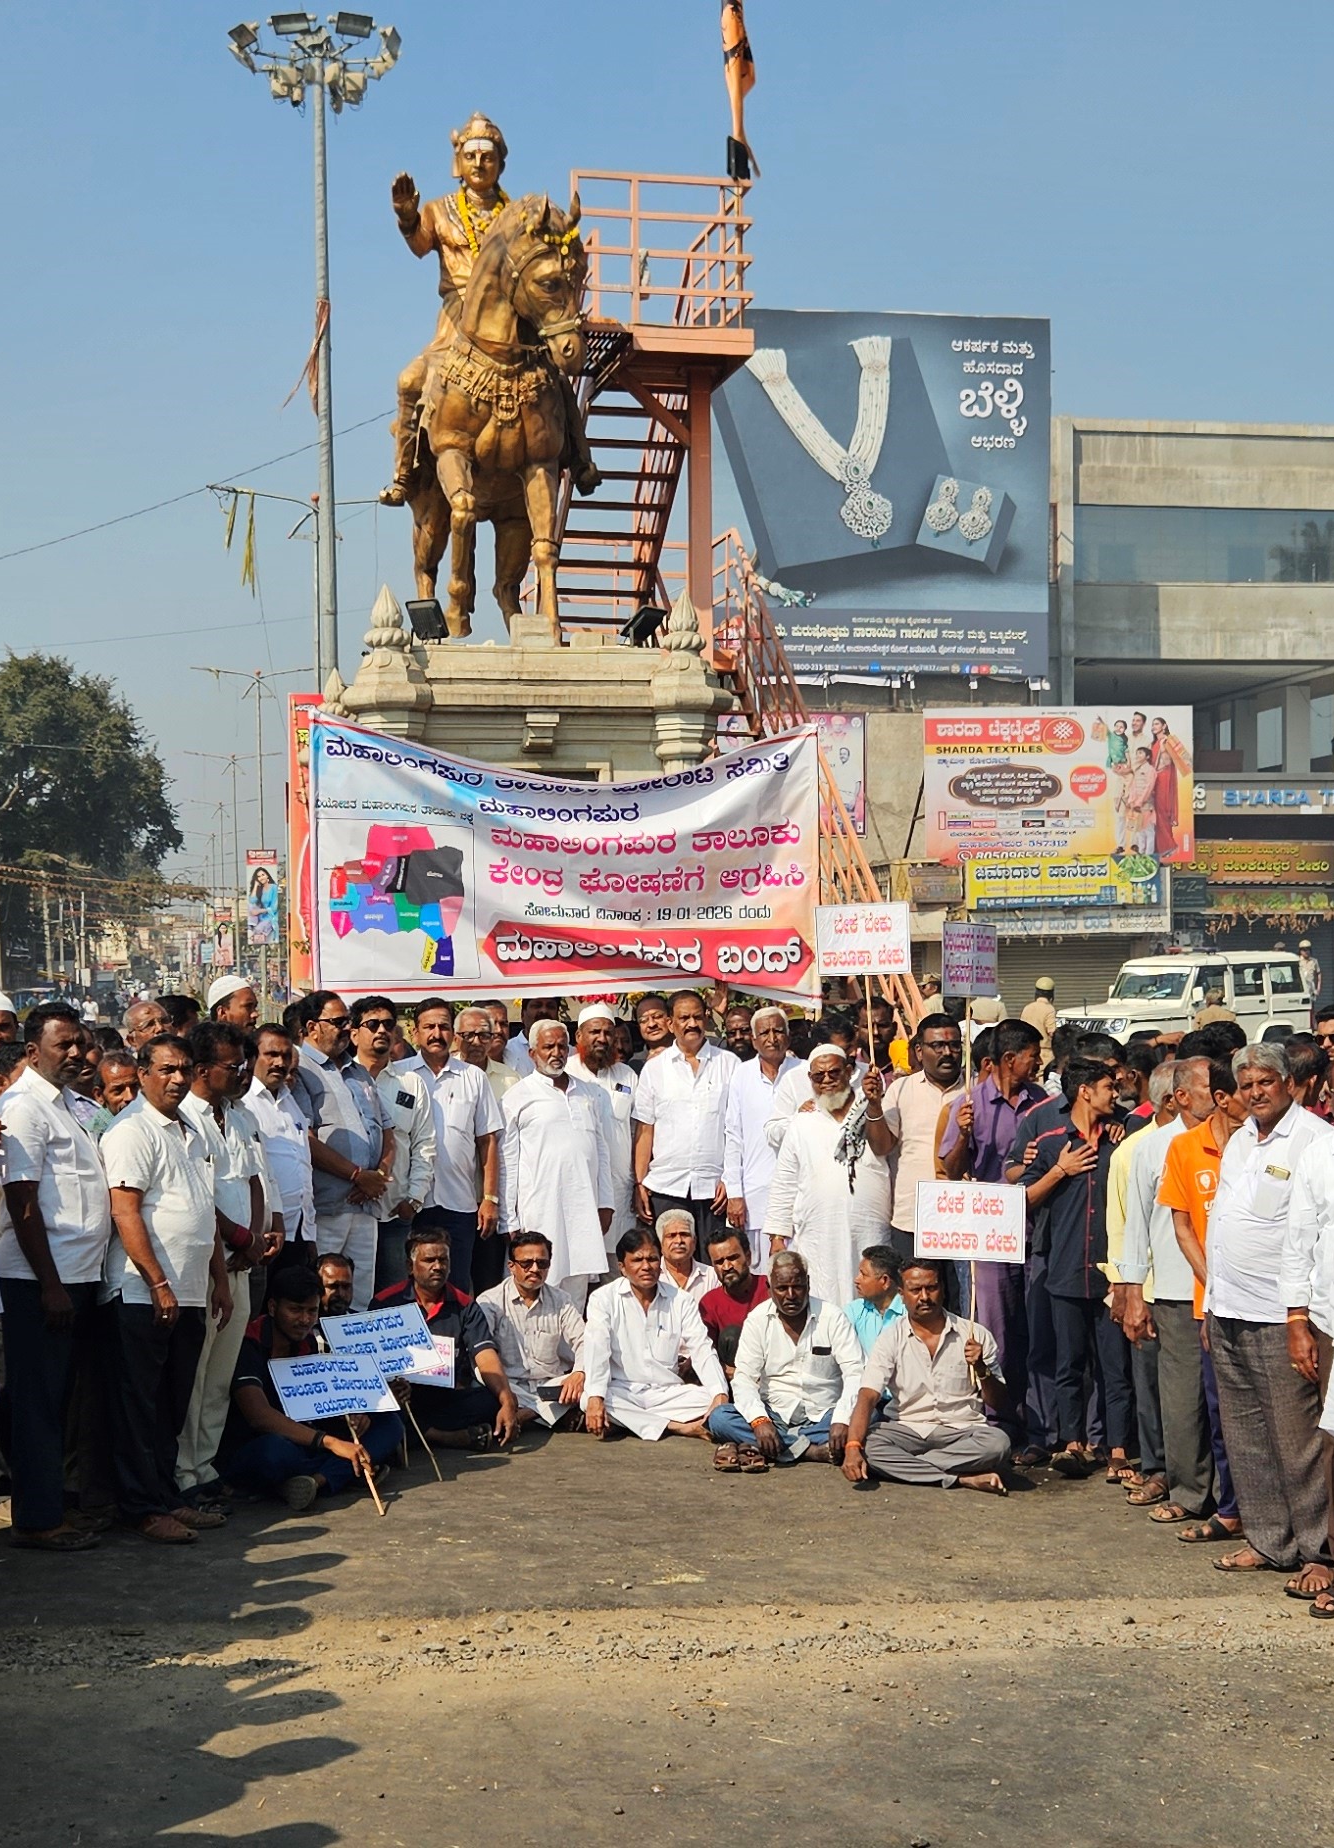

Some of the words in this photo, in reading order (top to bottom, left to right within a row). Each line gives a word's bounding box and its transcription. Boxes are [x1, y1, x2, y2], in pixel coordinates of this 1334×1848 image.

[951, 339, 999, 353] ಆಕರ್ಷಕ
[1002, 341, 1035, 359] ಮತ್ತು
[963, 360, 1023, 375] ಹೊಸದಾದ
[959, 378, 1027, 437] ಬೆಳ್ಳಿ
[971, 435, 1016, 451] ಆಭರಣ
[936, 721, 983, 737] ಶಾರದಾ
[936, 746, 983, 754] SHARDA
[987, 745, 1043, 754] TEXTILES
[326, 735, 483, 787] ಮಹಾಲಿಂಗಪುರ
[725, 752, 790, 781] ಸಮಿತಿ
[1223, 788, 1313, 807] SHARDA
[478, 798, 640, 823] ಮಹಾಲಿಂಗಪುರ
[490, 825, 677, 857] ಮಹಾಲಿಂಗಪುರ
[692, 817, 801, 852] ತಾಲೂಕು
[975, 863, 1042, 881] ಜಮಾದಾರ
[1048, 861, 1108, 878] ಪಾನಶಾಪ
[1295, 859, 1330, 873] ಬೇಕರಿ
[489, 857, 564, 896] ಕೇಂದ್ರ
[579, 864, 705, 897] ಘೋಷಣೆಗೆ
[720, 862, 805, 896] ಆಗ್ರಹಿಸಿ
[524, 902, 590, 919] ಸೋಮವಾರ
[595, 905, 642, 921] ದಿನಾಂಕ
[655, 907, 733, 921] 19-01-2026
[738, 905, 773, 920] ರಂದು
[864, 912, 892, 933] ಬೇಕು
[496, 930, 703, 974] ಮಹಾಲಿಂಗಪುರ
[717, 933, 802, 975] ಬಂದ್
[822, 950, 872, 967] ತಾಲೂಕಾ
[878, 944, 905, 965] ಬೇಕು
[972, 1191, 1004, 1215] ಬೇಕು
[922, 1229, 979, 1249] ತಾಲೂಕಾ
[985, 1228, 1018, 1253] ಬೇಕು
[341, 1314, 404, 1336] ಮಹಾಲಿಂಗಪುರ
[379, 1328, 432, 1351] ಹೋರಾಟಕ್ಕೆ
[290, 1359, 359, 1376] ಮಹಾಲಿಂಗಪುರ
[281, 1382, 328, 1398] ತಾಲೂಕಾ
[331, 1374, 386, 1395] ಹೋರಾಟಕ್ಕೆ
[313, 1397, 367, 1414] ಜಯವಾಗಲಿ
